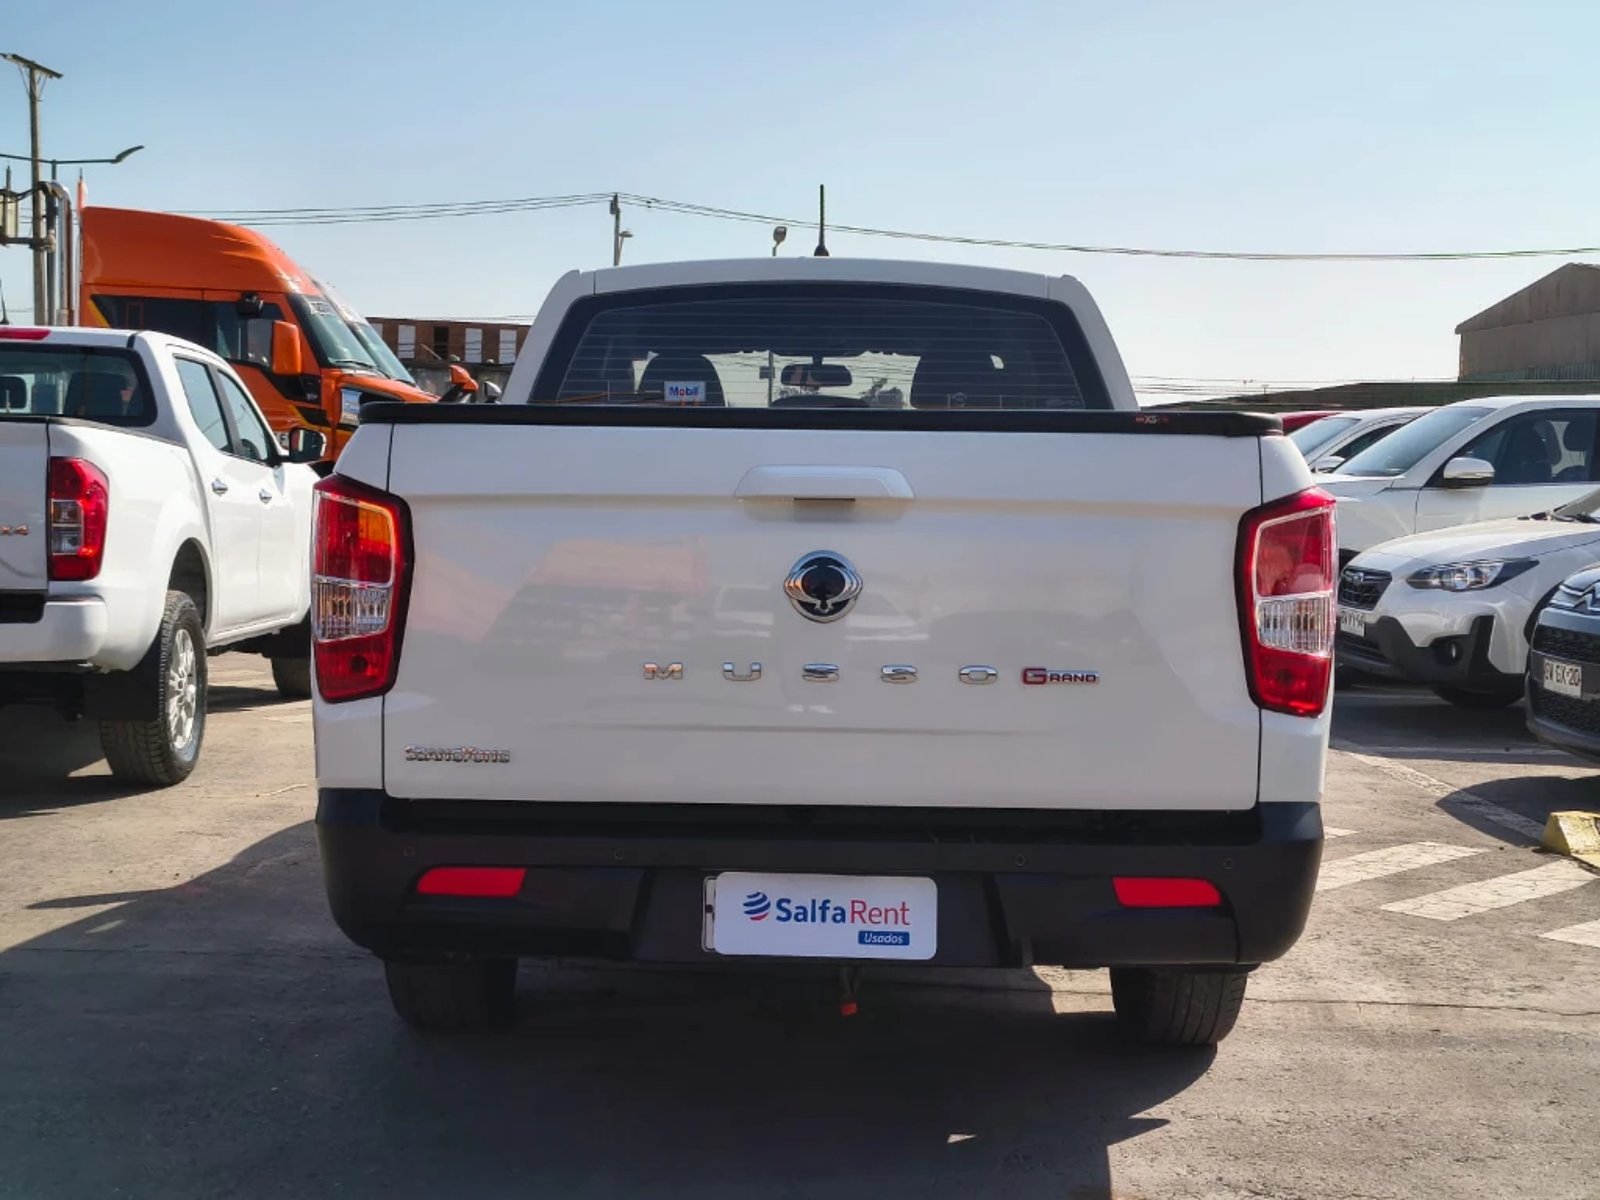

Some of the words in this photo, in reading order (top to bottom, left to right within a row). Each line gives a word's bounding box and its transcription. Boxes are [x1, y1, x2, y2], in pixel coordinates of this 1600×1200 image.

[643, 662, 998, 685] MUSSO
[776, 898, 910, 925] SalfaRent
[864, 932, 903, 944] Usados
